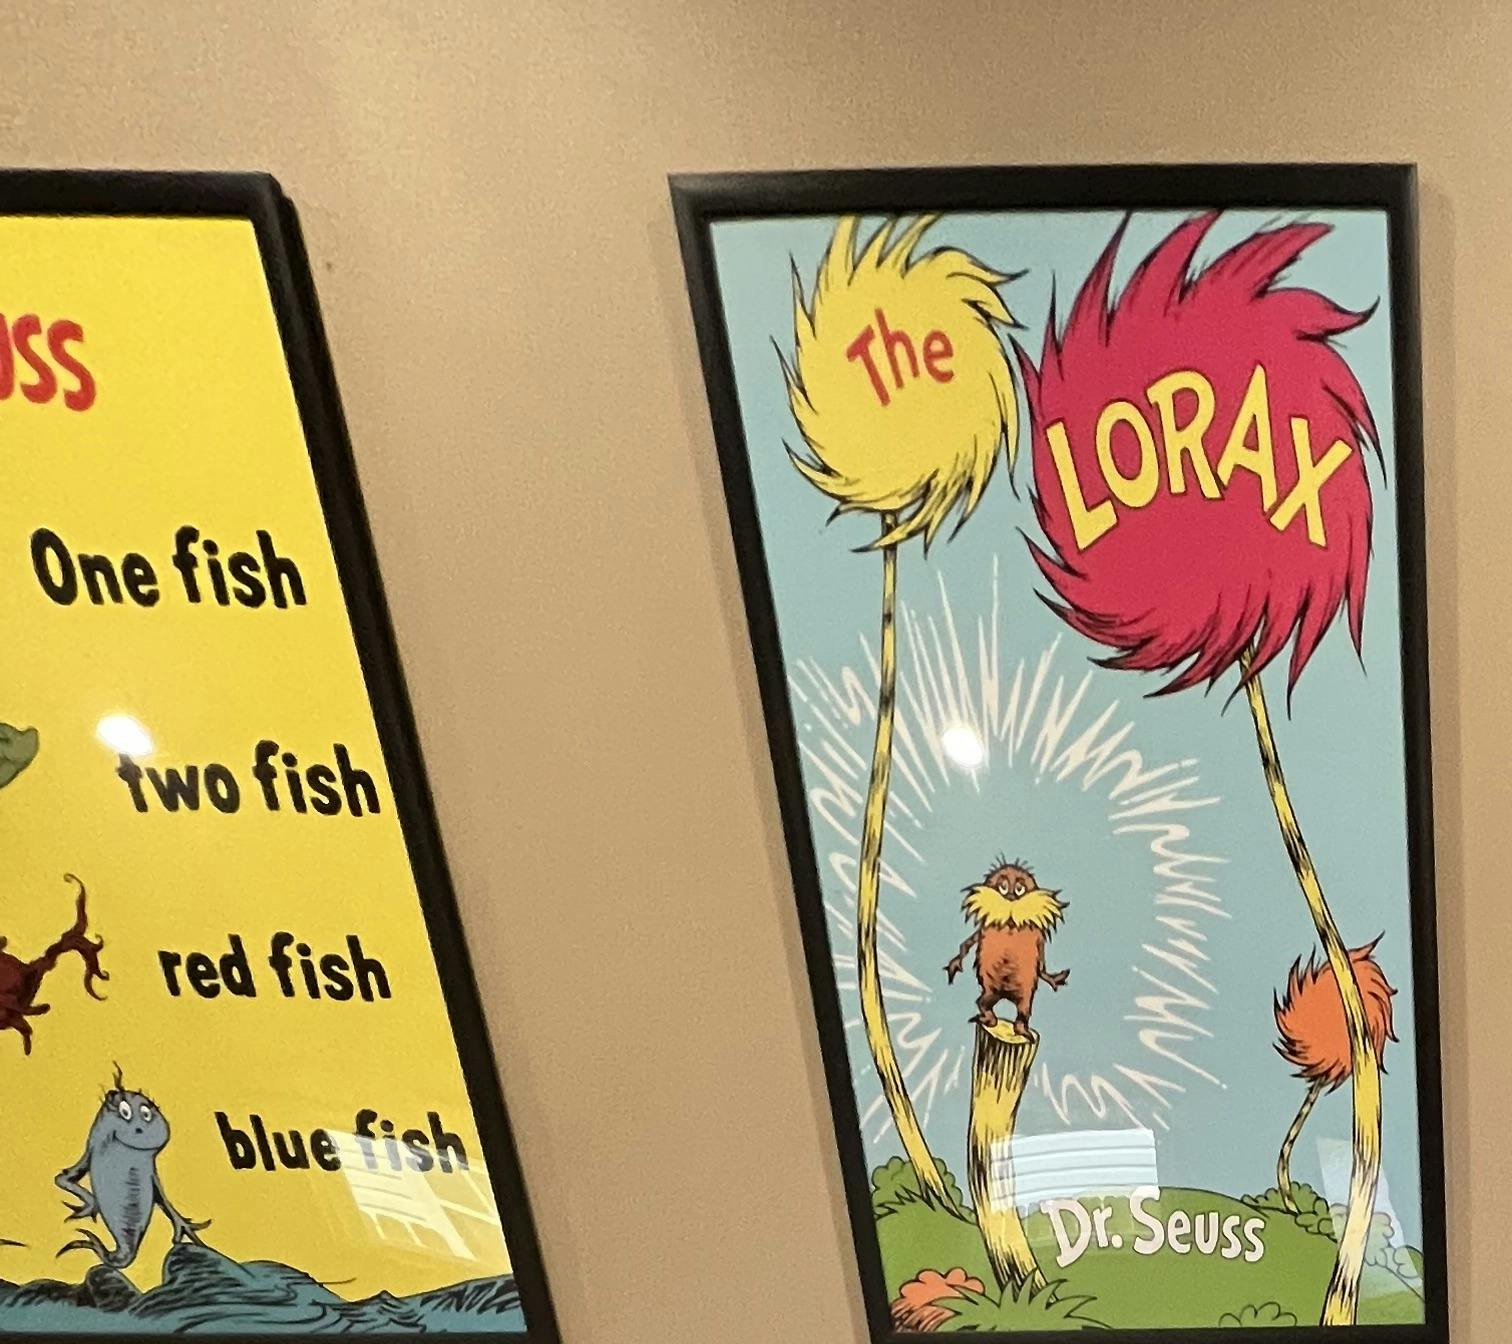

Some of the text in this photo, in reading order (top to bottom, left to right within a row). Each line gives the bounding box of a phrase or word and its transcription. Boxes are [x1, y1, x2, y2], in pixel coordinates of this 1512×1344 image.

[846, 310, 955, 404] The
[1046, 364, 1353, 550] LORAX
[30, 526, 307, 610] One fish
[117, 739, 381, 818] two fish
[157, 931, 392, 1003] red fish
[213, 1108, 469, 1174] blue fish
[1040, 1185, 1266, 1268] Dr. Seuss
